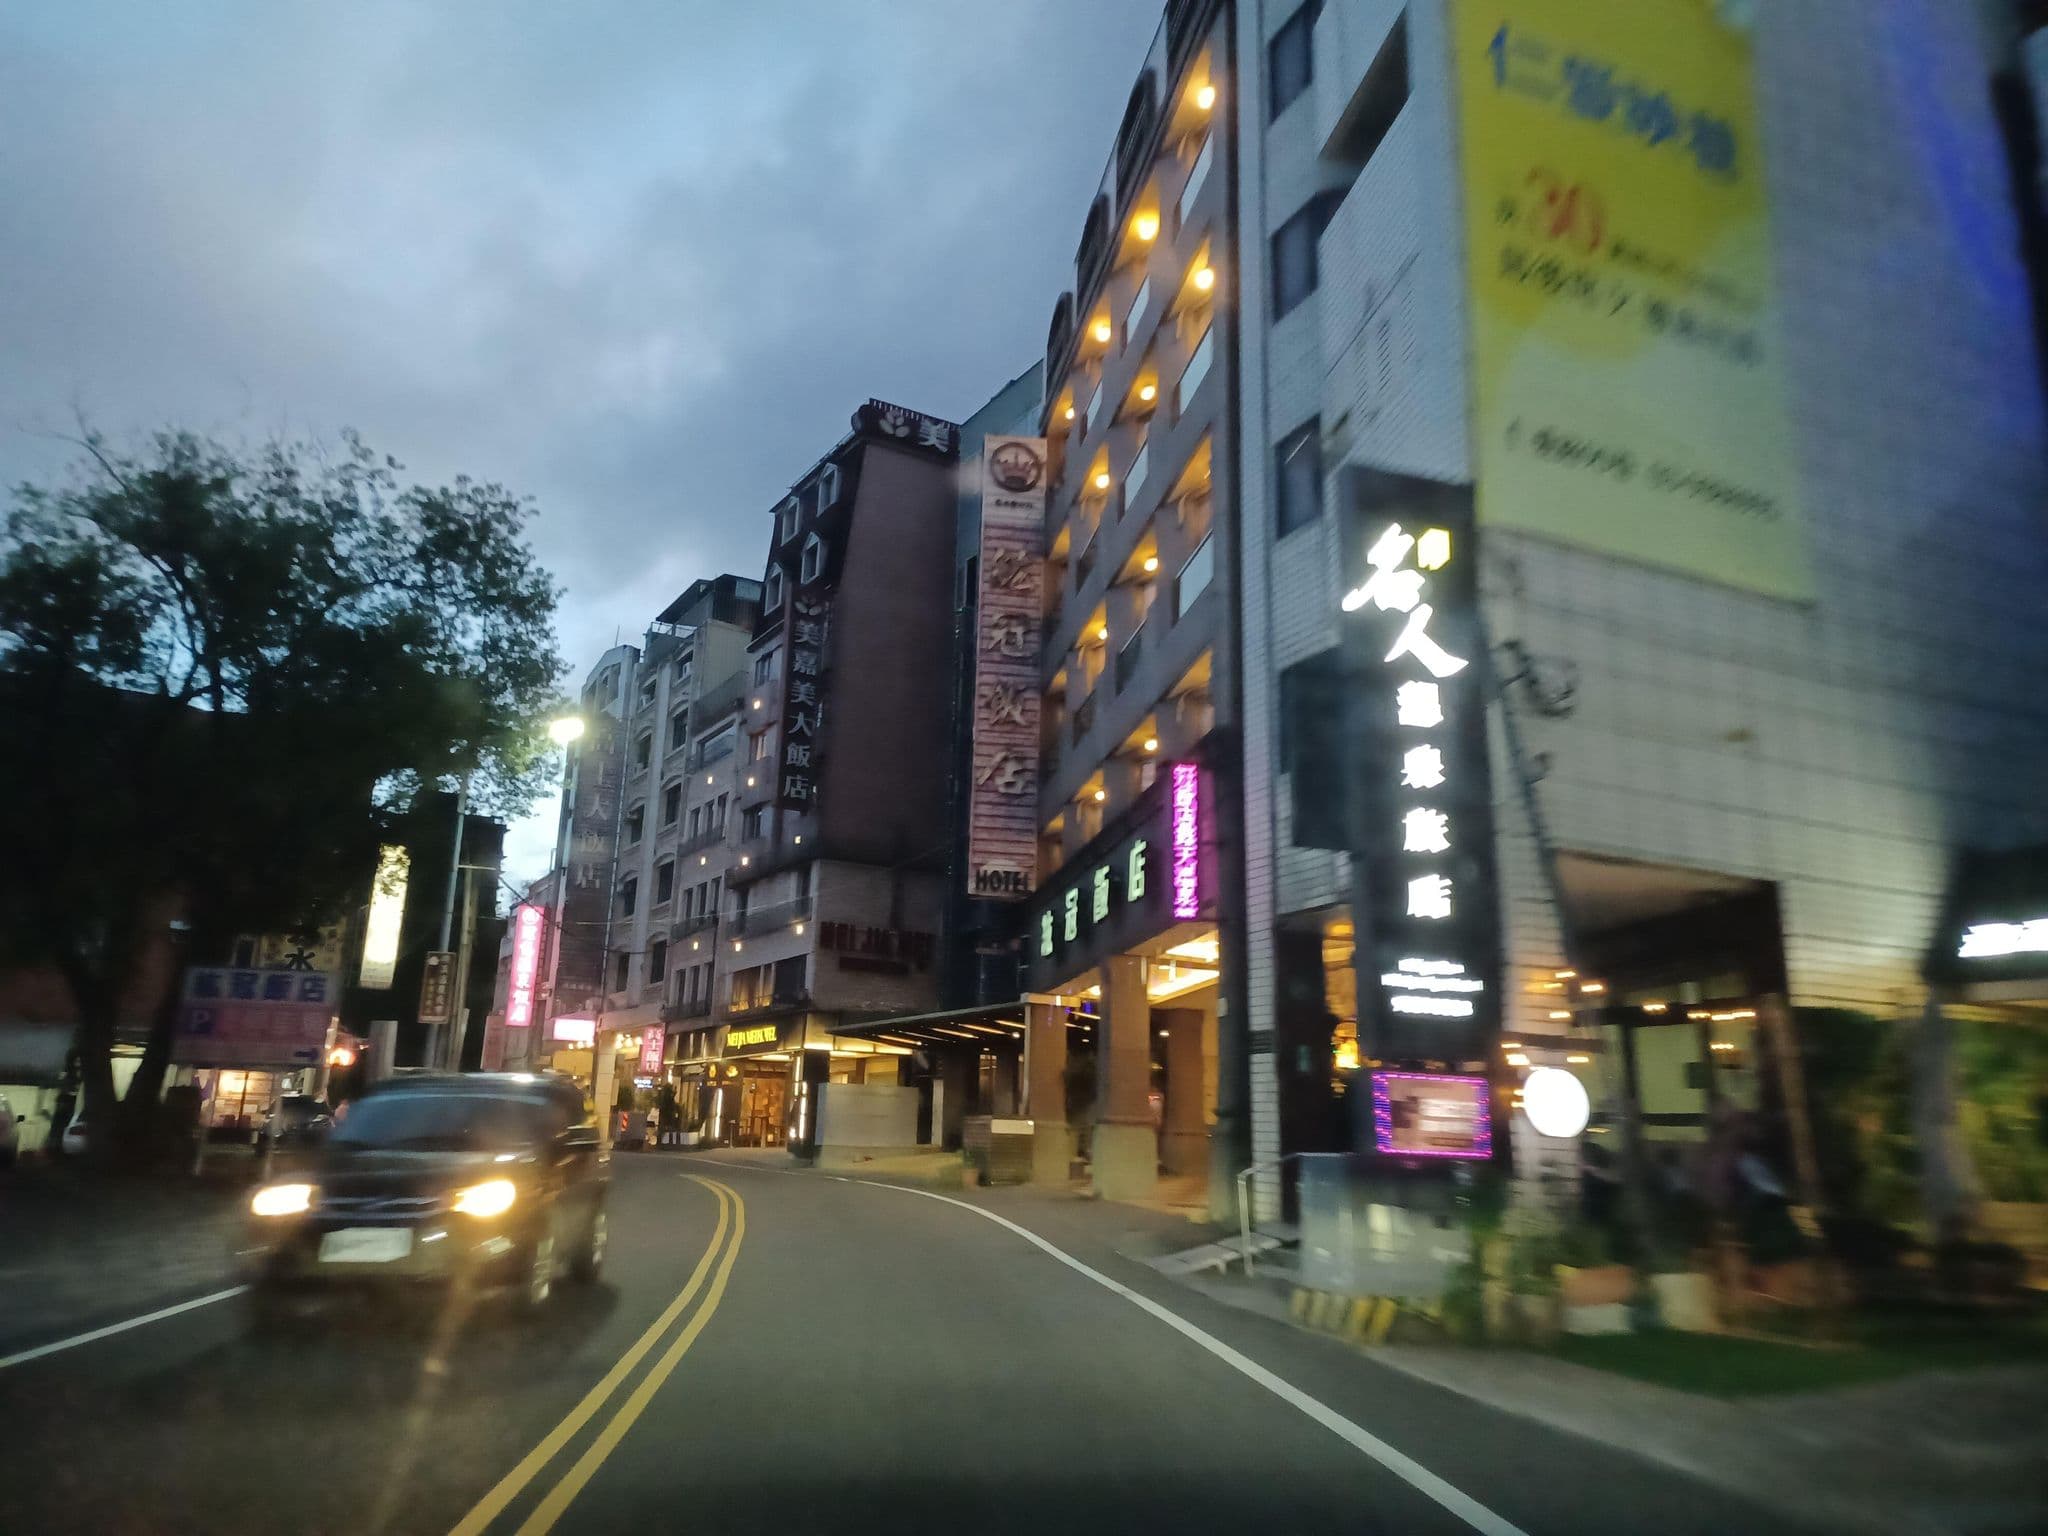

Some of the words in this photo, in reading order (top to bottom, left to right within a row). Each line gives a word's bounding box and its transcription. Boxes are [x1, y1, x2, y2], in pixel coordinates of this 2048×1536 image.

[782, 619, 822, 802] 美嘉美大飯店
[975, 869, 1032, 894] HOTEL
